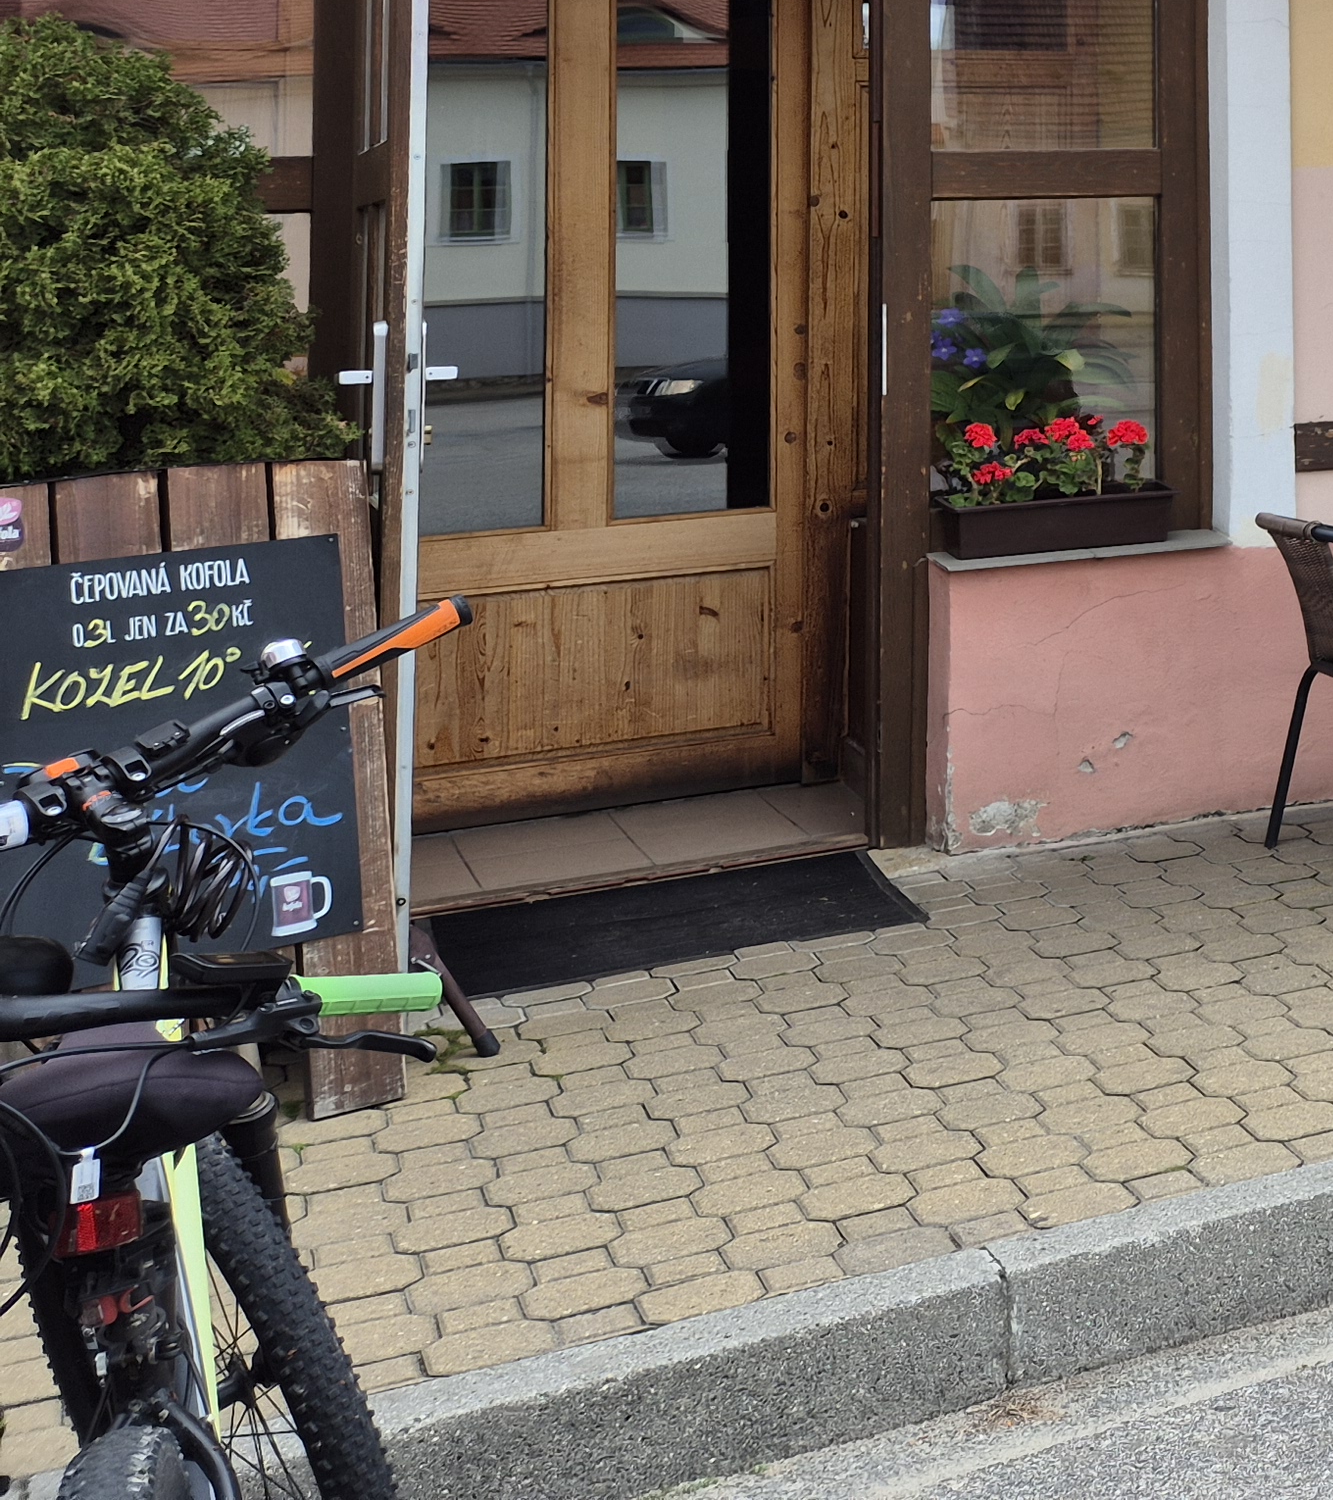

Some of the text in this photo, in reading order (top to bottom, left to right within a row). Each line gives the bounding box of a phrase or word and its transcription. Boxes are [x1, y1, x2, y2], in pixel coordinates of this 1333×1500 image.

[69, 557, 250, 605] ČEPOVANÁ KOFOLA
[124, 614, 157, 641] JEN
[165, 610, 188, 636] ZA
[20, 655, 176, 720] KOZEL
